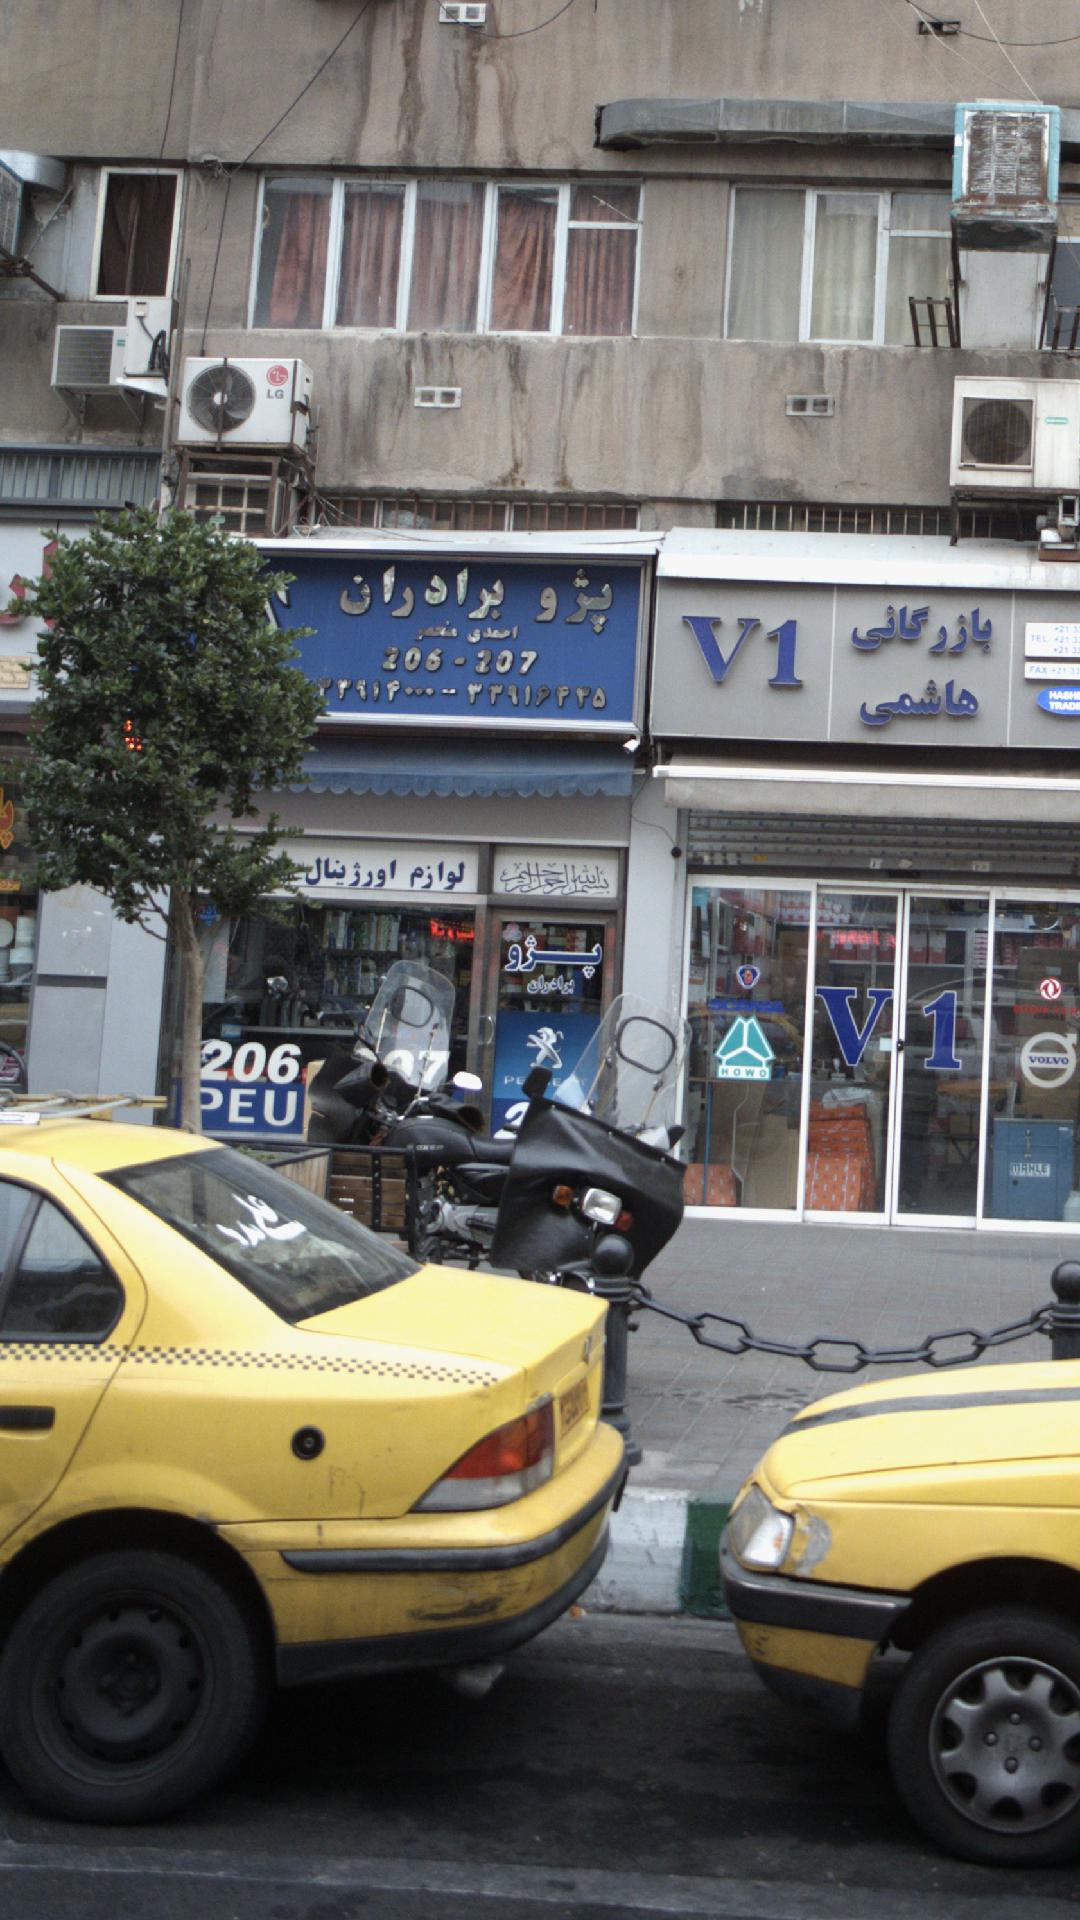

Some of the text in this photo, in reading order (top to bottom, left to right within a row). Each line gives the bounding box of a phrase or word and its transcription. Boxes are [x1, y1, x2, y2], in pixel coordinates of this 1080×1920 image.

[267, 389, 285, 399] LG
[339, 566, 613, 633] پژو برادران
[851, 605, 993, 655] بازرگانی
[383, 647, 443, 672] 206
[475, 649, 538, 674] 207
[682, 616, 803, 686] V1
[1029, 666, 1048, 675] FAX
[860, 679, 980, 726] هاشمی
[305, 857, 466, 890] لوازم اورژینال
[504, 935, 603, 979] پژو
[200, 1038, 302, 1084] 206
[721, 1068, 767, 1077] HOWO
[1028, 1056, 1070, 1065] VOLVO
